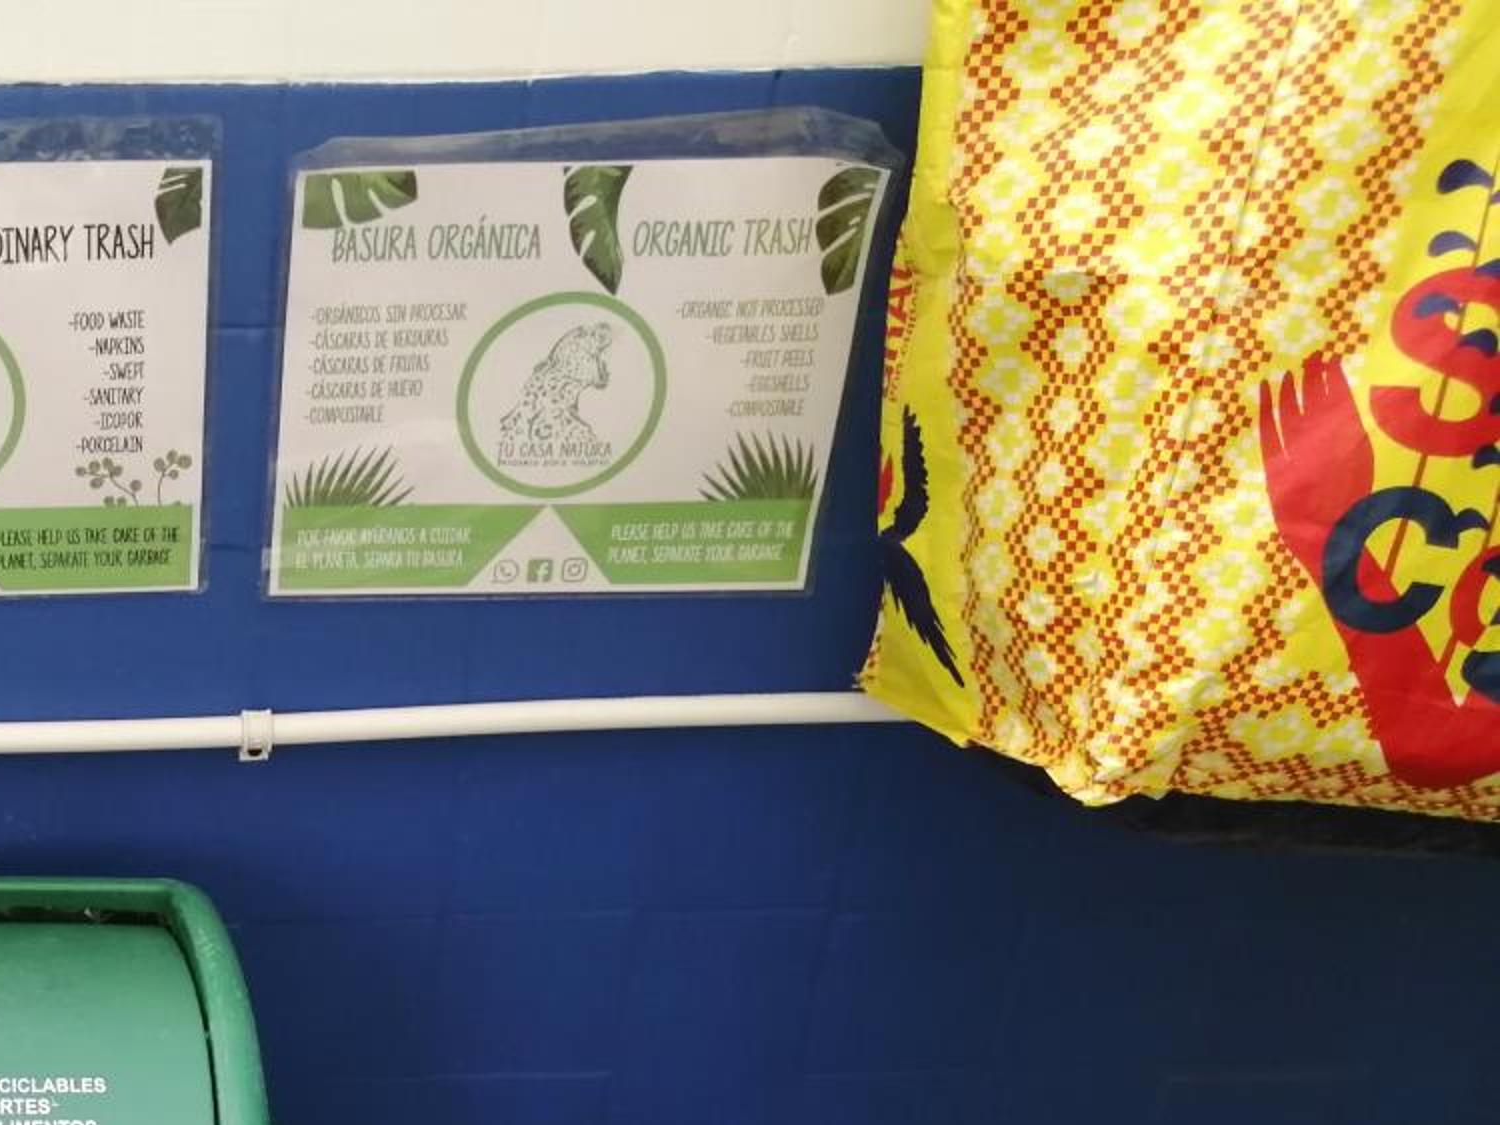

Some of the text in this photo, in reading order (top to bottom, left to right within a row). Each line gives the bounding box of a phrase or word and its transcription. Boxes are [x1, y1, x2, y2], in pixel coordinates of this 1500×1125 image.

[84, 223, 154, 260] TRASH
[332, 214, 541, 263] BASURA ORGÁNICA
[633, 217, 813, 256] ORGANIC TRASH
[109, 310, 145, 329] WASTE
[386, 304, 406, 323] SIN
[375, 330, 388, 348] DE
[373, 355, 385, 372] DE
[389, 353, 430, 372] FRUTAS
[371, 380, 383, 398] DE
[387, 379, 423, 397] HUEVO
[520, 442, 553, 457] CASA
[560, 441, 612, 457] NATURA
[37, 529, 62, 545] HELP
[67, 528, 80, 545] US
[85, 528, 107, 545] TAKE
[113, 528, 138, 544] CARE
[143, 527, 155, 543] OF
[162, 527, 180, 542] THE
[41, 551, 89, 568] SEPARATE
[93, 550, 121, 567] YOUR
